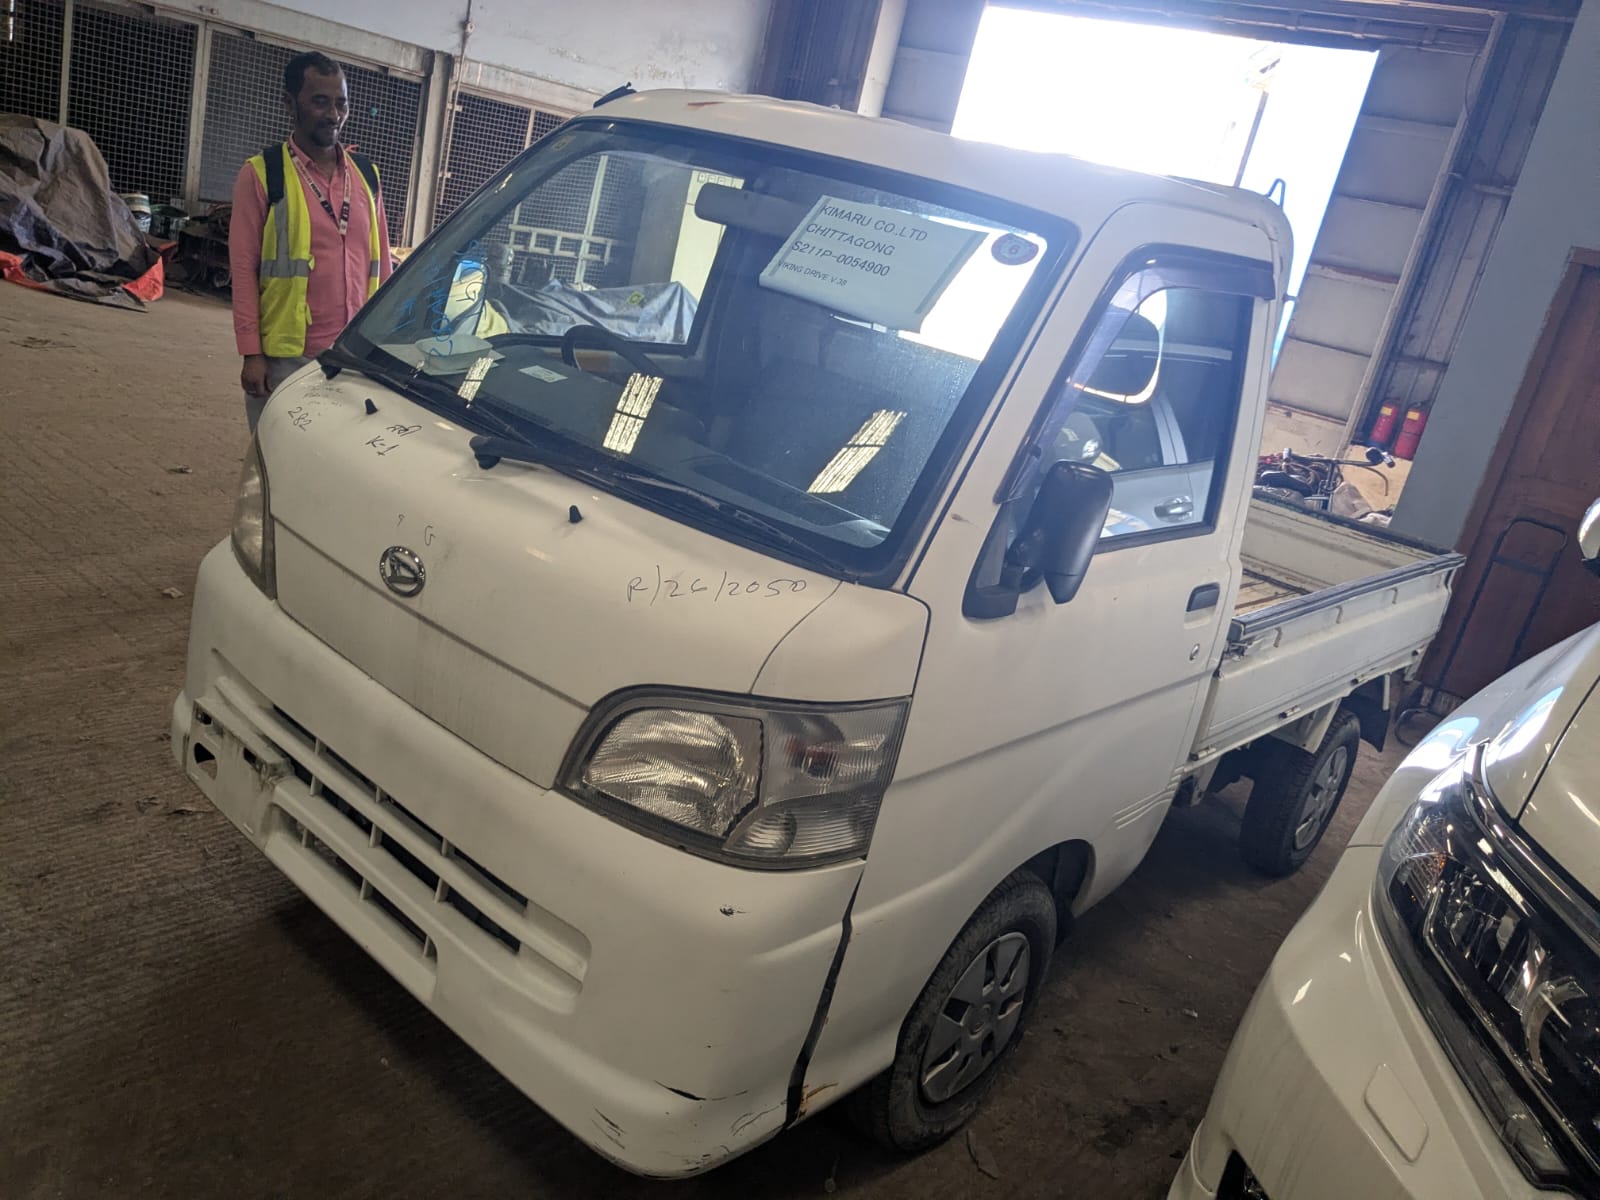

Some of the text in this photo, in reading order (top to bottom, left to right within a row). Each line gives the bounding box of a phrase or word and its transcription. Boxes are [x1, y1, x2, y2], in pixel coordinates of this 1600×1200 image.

[819, 204, 871, 228] KIMARU
[806, 223, 896, 257] CHITTAGONG
[791, 240, 891, 277] S211P-0054900
[803, 267, 830, 281] DRIVE
